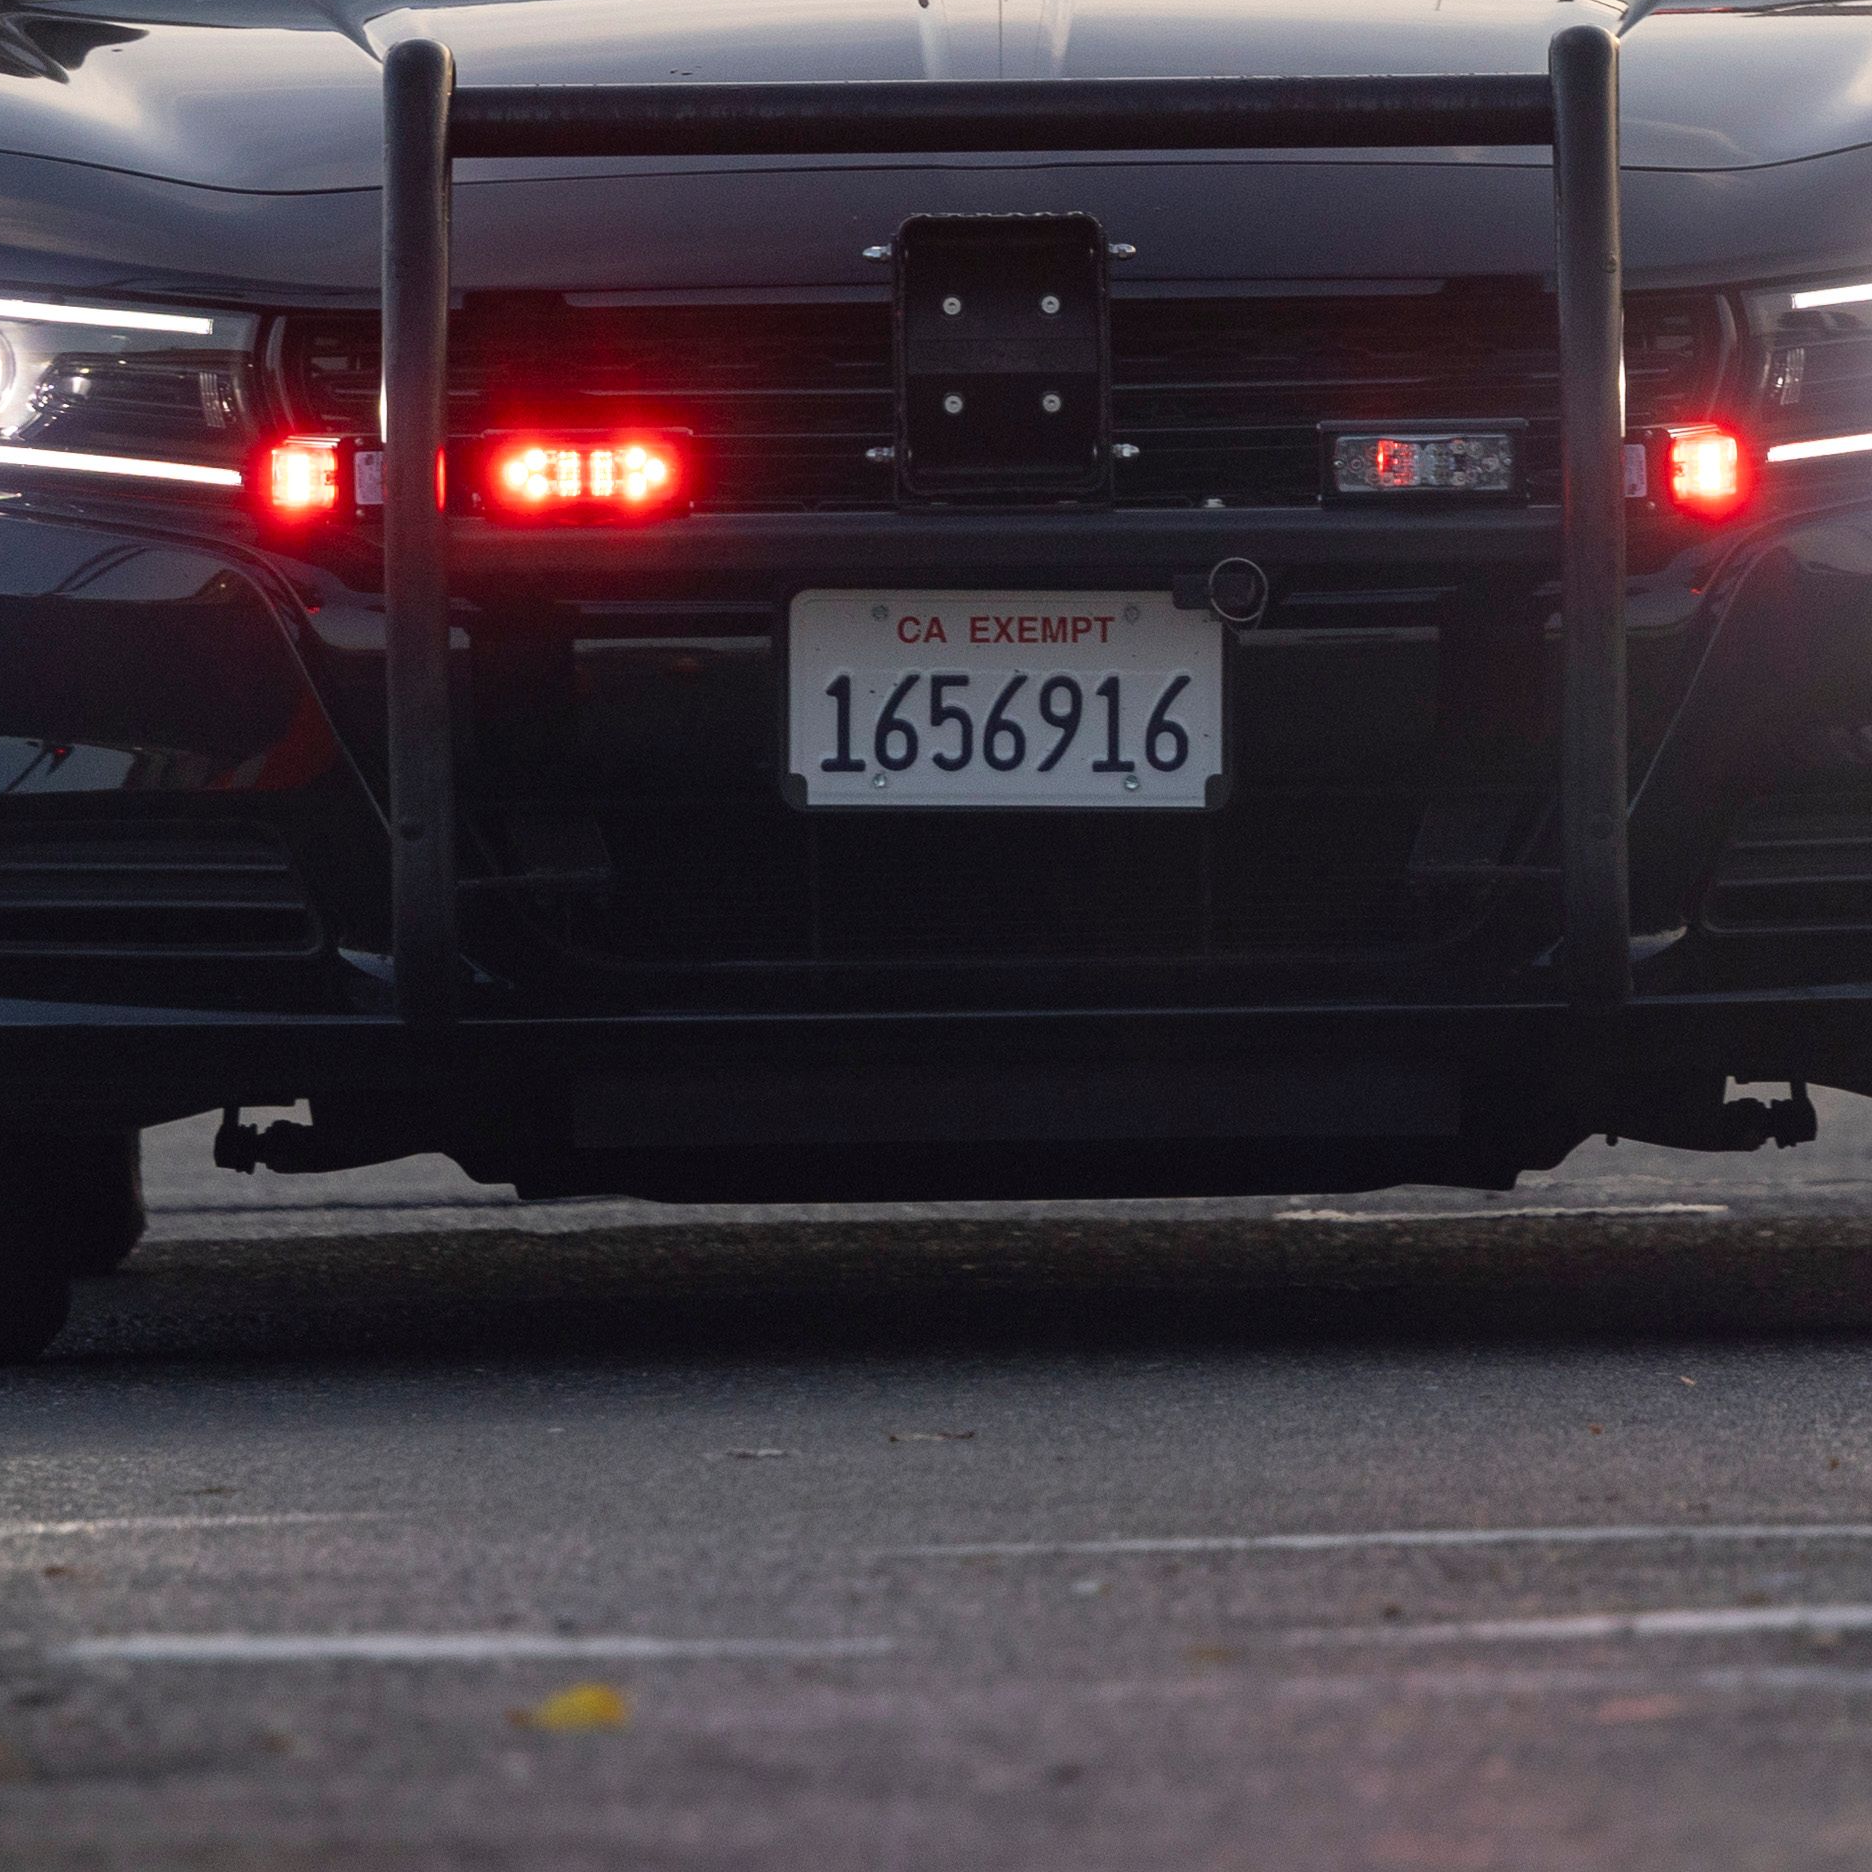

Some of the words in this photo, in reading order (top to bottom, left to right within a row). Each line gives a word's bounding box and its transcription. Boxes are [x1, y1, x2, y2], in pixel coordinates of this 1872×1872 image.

[896, 615, 948, 644] CA
[969, 615, 1116, 644] EXEMPT
[820, 673, 1192, 773] 1656916
